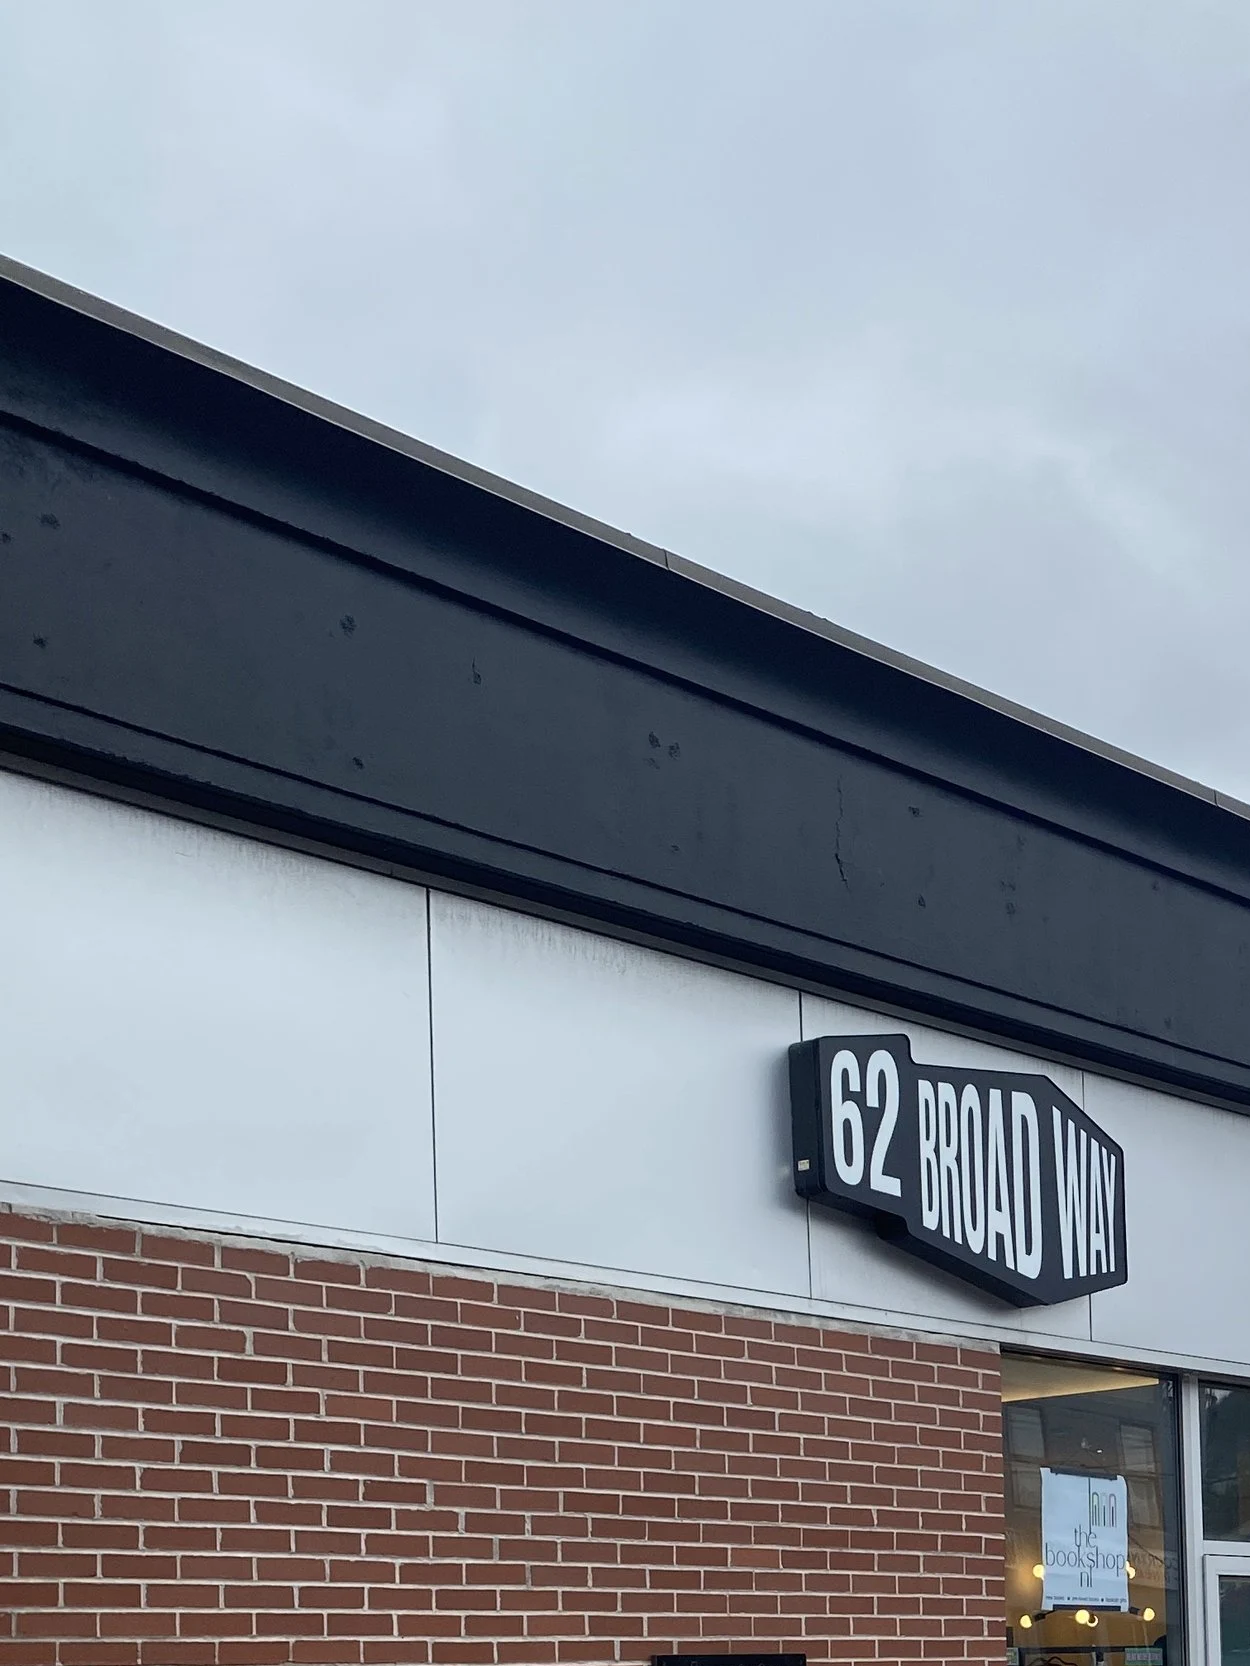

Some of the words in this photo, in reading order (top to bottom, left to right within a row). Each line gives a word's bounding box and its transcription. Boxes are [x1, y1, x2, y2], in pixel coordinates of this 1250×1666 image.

[830, 1049, 902, 1197] 62
[917, 1078, 1043, 1280] BROAD
[1051, 1104, 1117, 1280] WAY
[1074, 1524, 1097, 1548] the
[1045, 1542, 1125, 1577] bookshop
